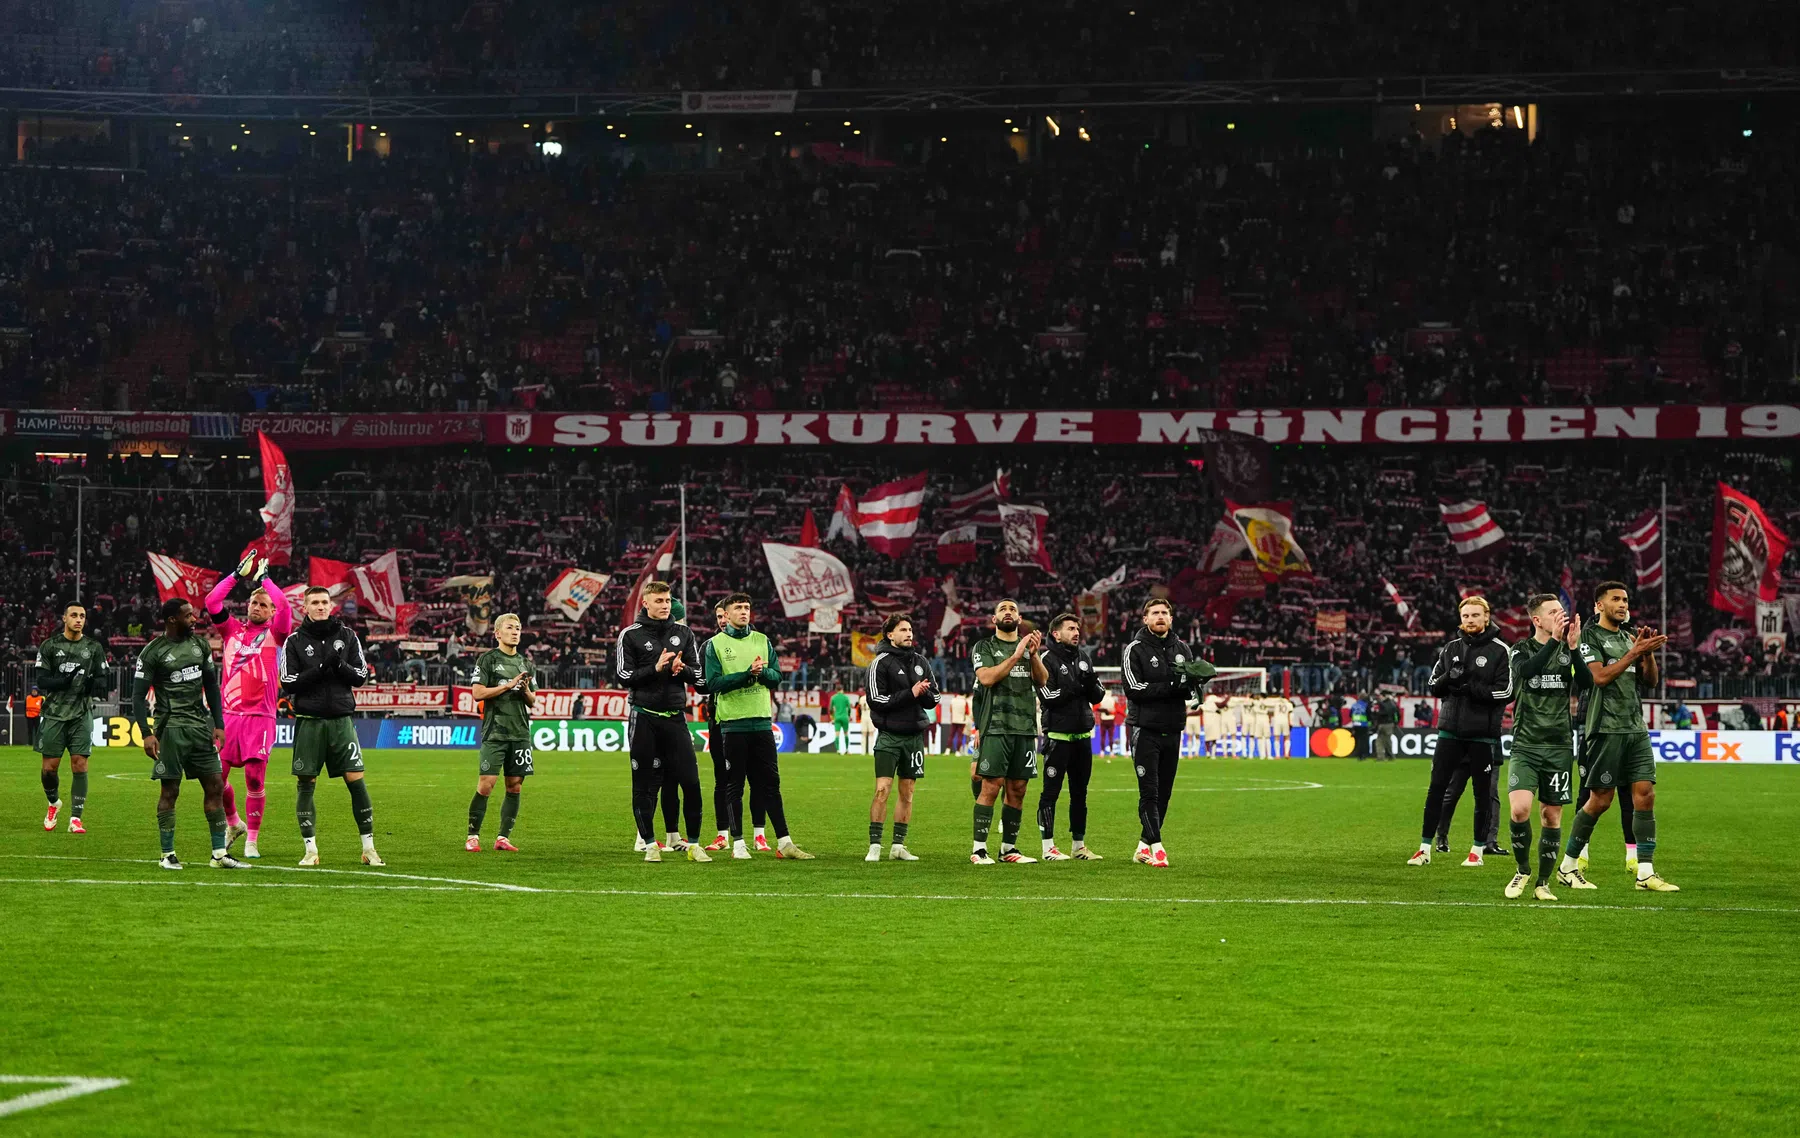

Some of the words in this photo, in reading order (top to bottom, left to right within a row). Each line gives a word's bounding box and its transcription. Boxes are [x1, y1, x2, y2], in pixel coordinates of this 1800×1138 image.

[553, 412, 1094, 446] SÜDKURVE
[262, 730, 267, 747] 1
[397, 725, 476, 745] #FOOTBALL
[348, 741, 362, 760] 2
[515, 748, 532, 766] 38
[911, 750, 923, 768] 10
[1025, 750, 1037, 767] 20
[1549, 771, 1569, 793] 42
